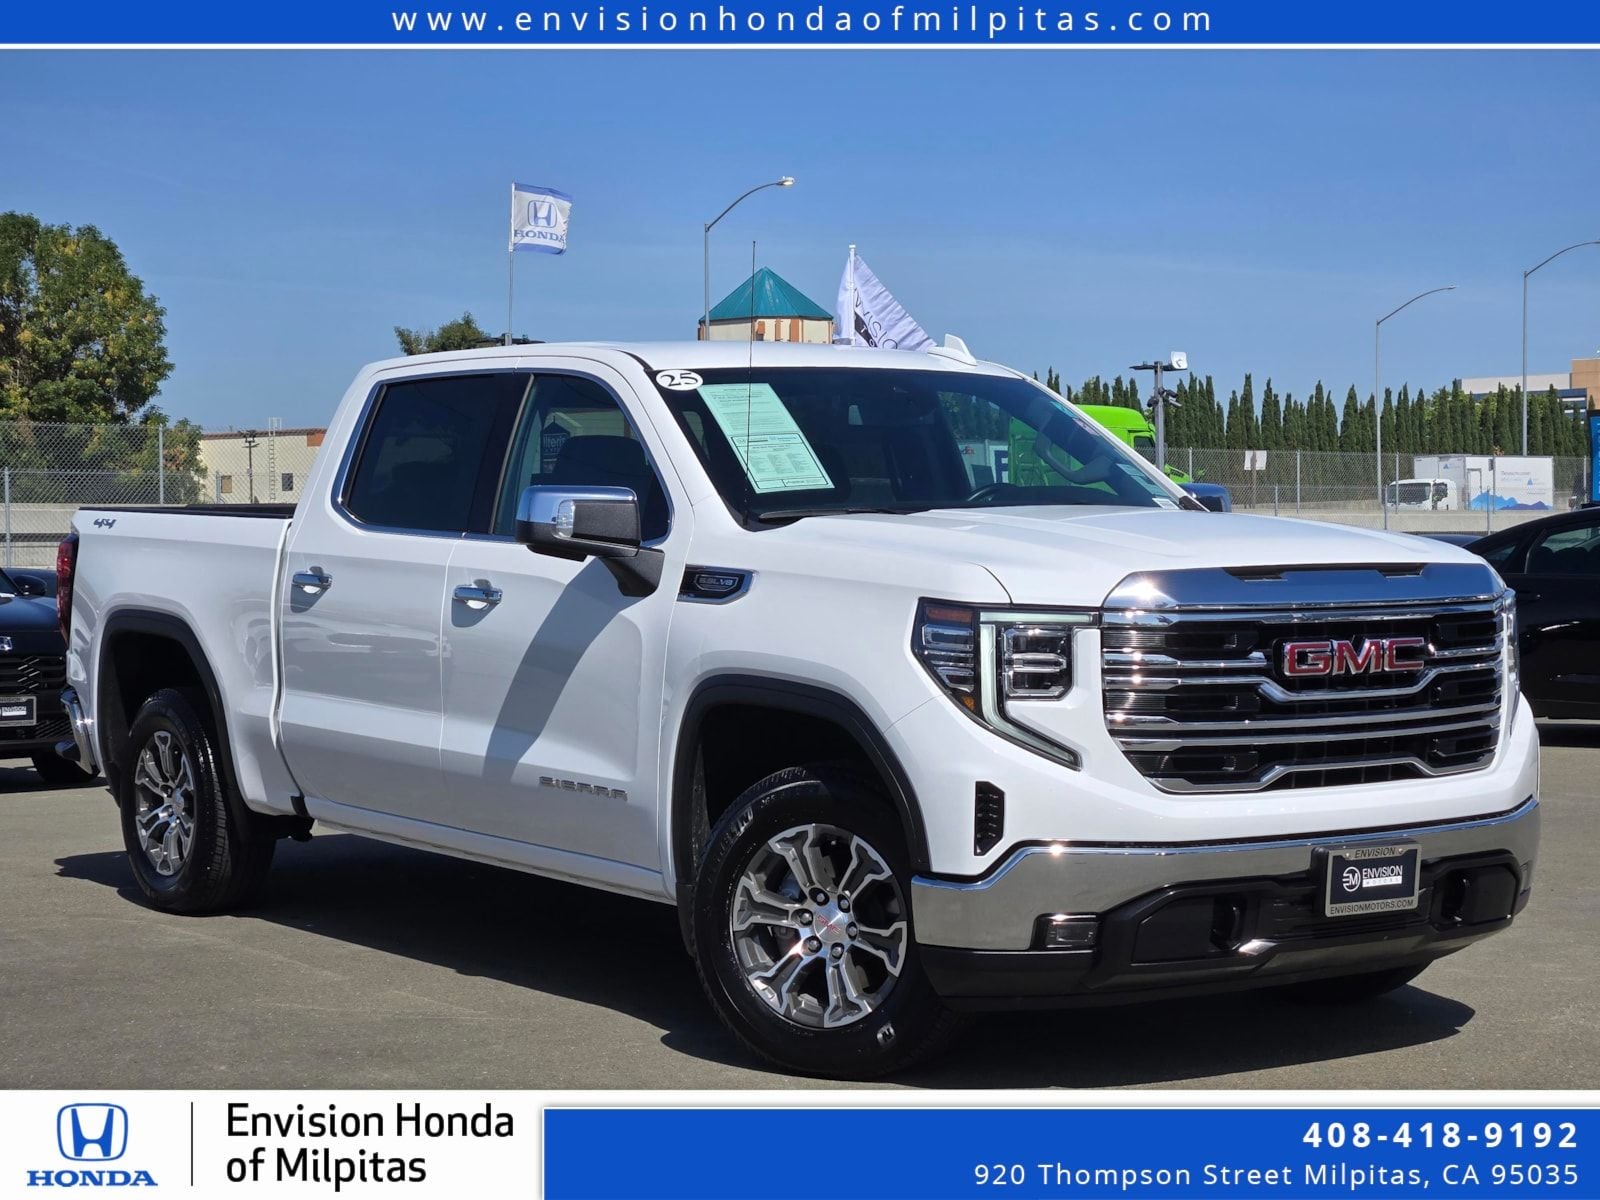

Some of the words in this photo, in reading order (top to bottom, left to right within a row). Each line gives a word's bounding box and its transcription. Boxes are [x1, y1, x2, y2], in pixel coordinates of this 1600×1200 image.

[514, 229, 565, 243] HONDA
[660, 372, 699, 387] 25
[1283, 637, 1425, 677] GMC
[539, 776, 628, 801] SIERRA
[1354, 847, 1396, 859] ENVISION
[1362, 865, 1403, 879] ENVISION
[1330, 899, 1414, 914] ENVISIONMOTORS.COM
